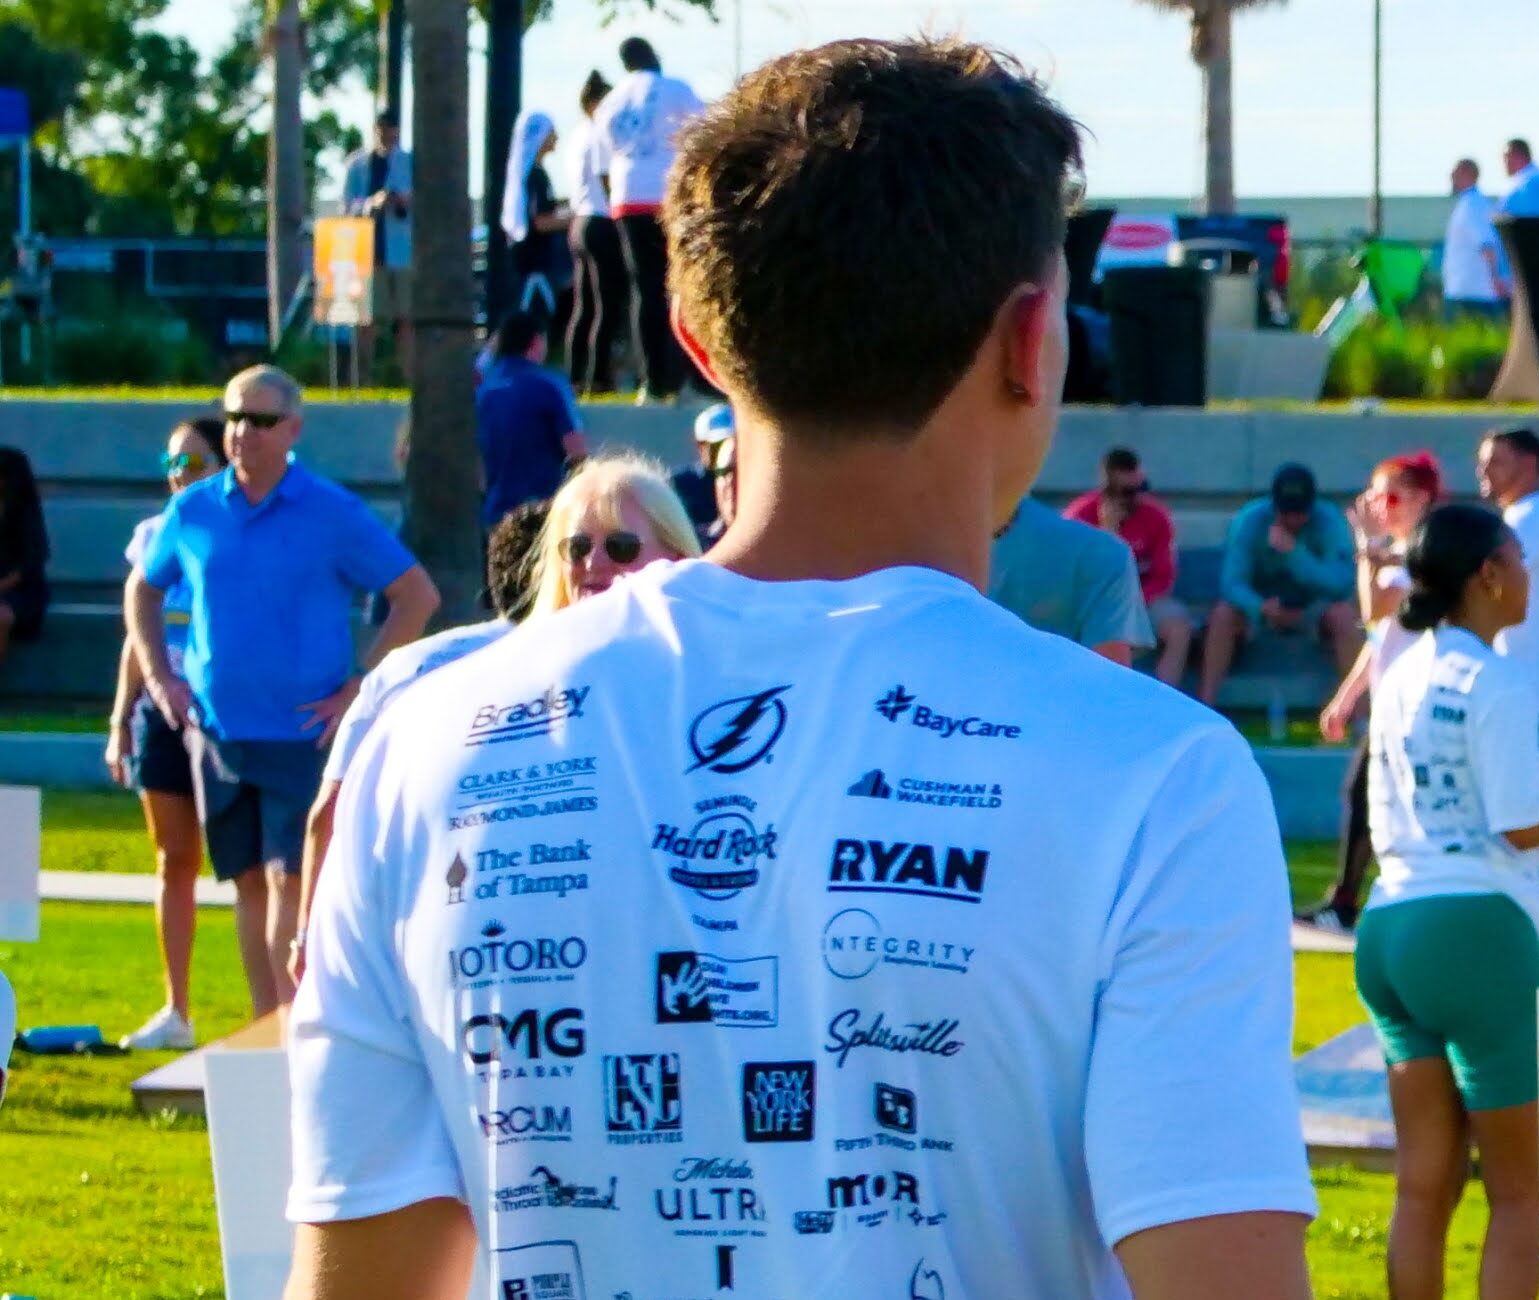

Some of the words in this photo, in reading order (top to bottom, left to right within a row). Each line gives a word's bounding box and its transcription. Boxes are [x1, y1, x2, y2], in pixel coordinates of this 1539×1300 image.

[471, 684, 592, 731] Bradley
[913, 705, 1022, 738] BayCare
[457, 769, 522, 789] CLARK
[546, 757, 597, 776] YORK
[900, 778, 987, 795] CUSHMAN
[898, 790, 1002, 809] WAKEFIELD
[477, 848, 522, 871] The
[529, 838, 592, 865] Bank
[651, 823, 726, 860] Hard
[723, 823, 778, 865] Rock
[829, 838, 991, 893] RYAN
[475, 876, 504, 899] of
[506, 873, 589, 898] Tampa
[464, 1008, 587, 1064] CMG
[825, 1008, 965, 1068] Splitsville
[534, 1065, 574, 1078] BAY
[753, 1070, 808, 1091] NEW
[745, 1088, 811, 1112] YORK
[753, 1109, 804, 1133] LIFE
